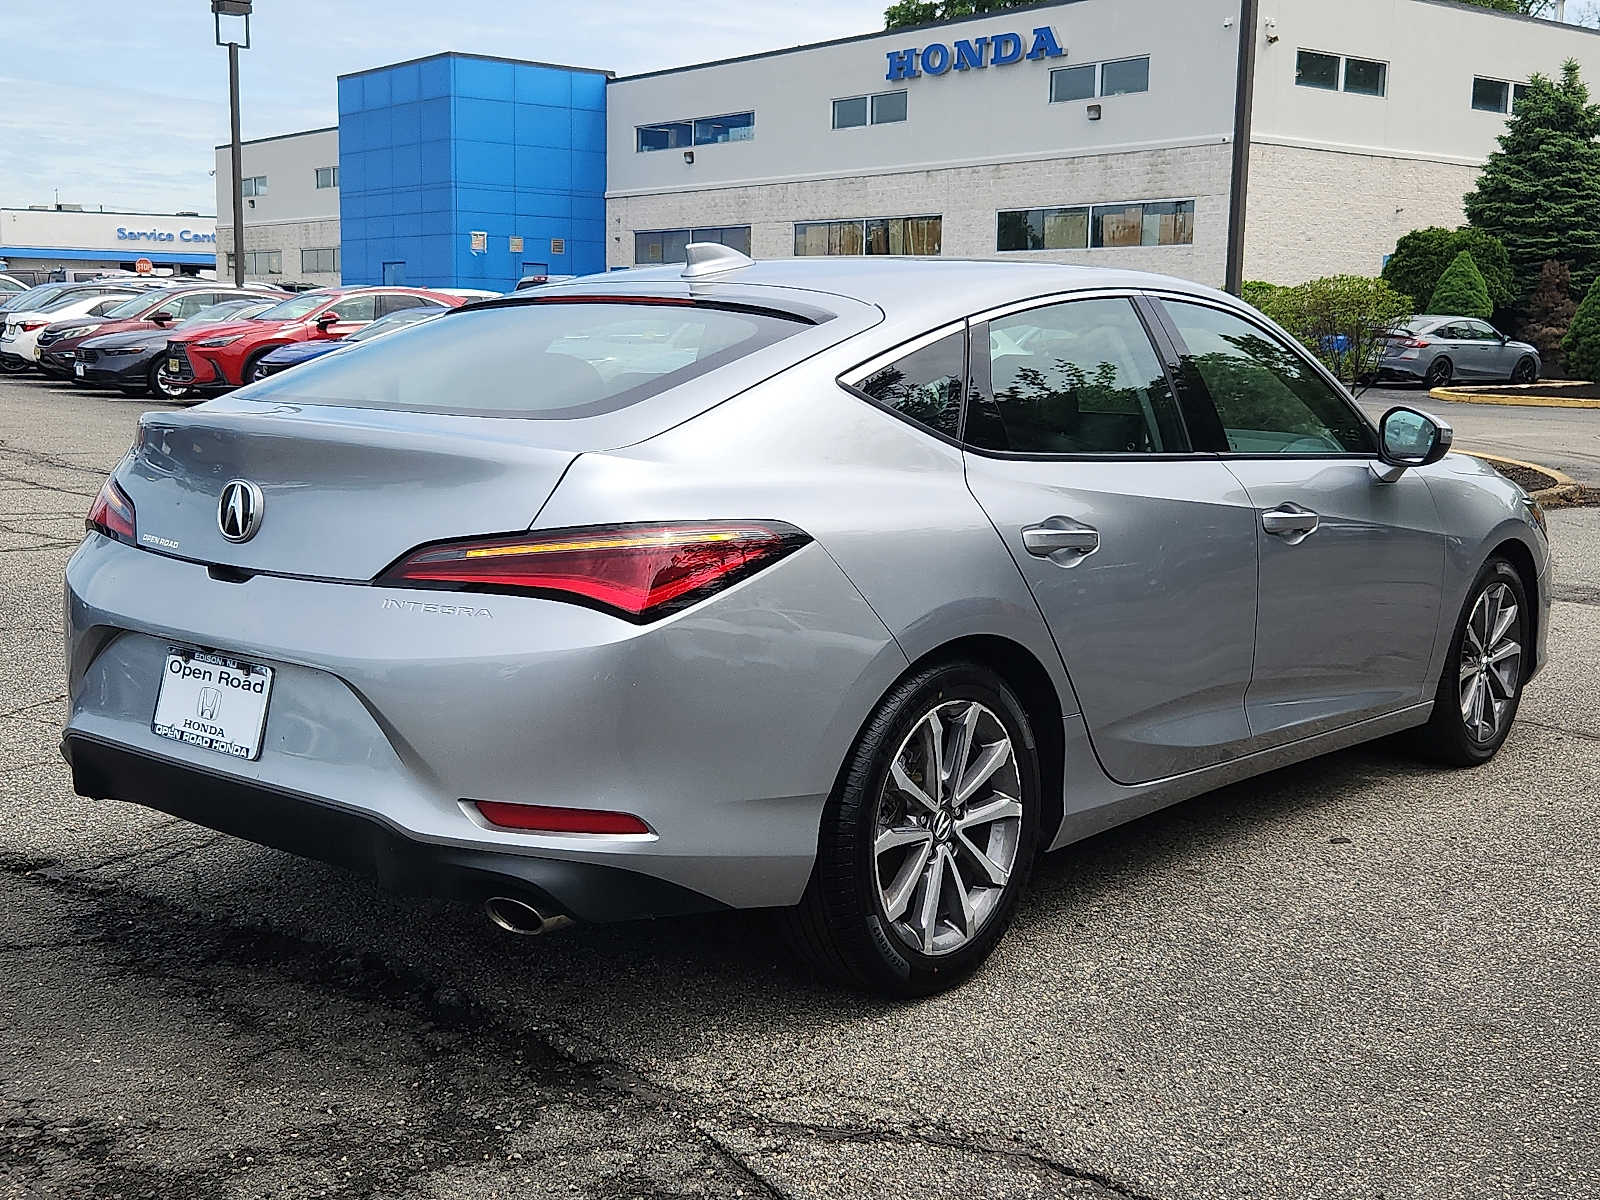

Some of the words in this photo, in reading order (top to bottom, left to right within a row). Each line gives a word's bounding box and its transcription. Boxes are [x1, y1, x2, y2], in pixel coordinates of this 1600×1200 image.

[886, 26, 1064, 80] HONDA
[117, 228, 174, 241] Service
[136, 263, 152, 271] STOP
[143, 534, 160, 544] OPEN
[160, 538, 179, 549] ROAD
[382, 598, 494, 619] INTEGRA
[227, 660, 238, 669] NJ
[169, 659, 213, 682] Open
[217, 670, 265, 694] Road
[183, 718, 225, 738] HONDA
[155, 724, 182, 740] OPEN
[182, 730, 211, 748] ROAD
[211, 739, 249, 759] HONDA
